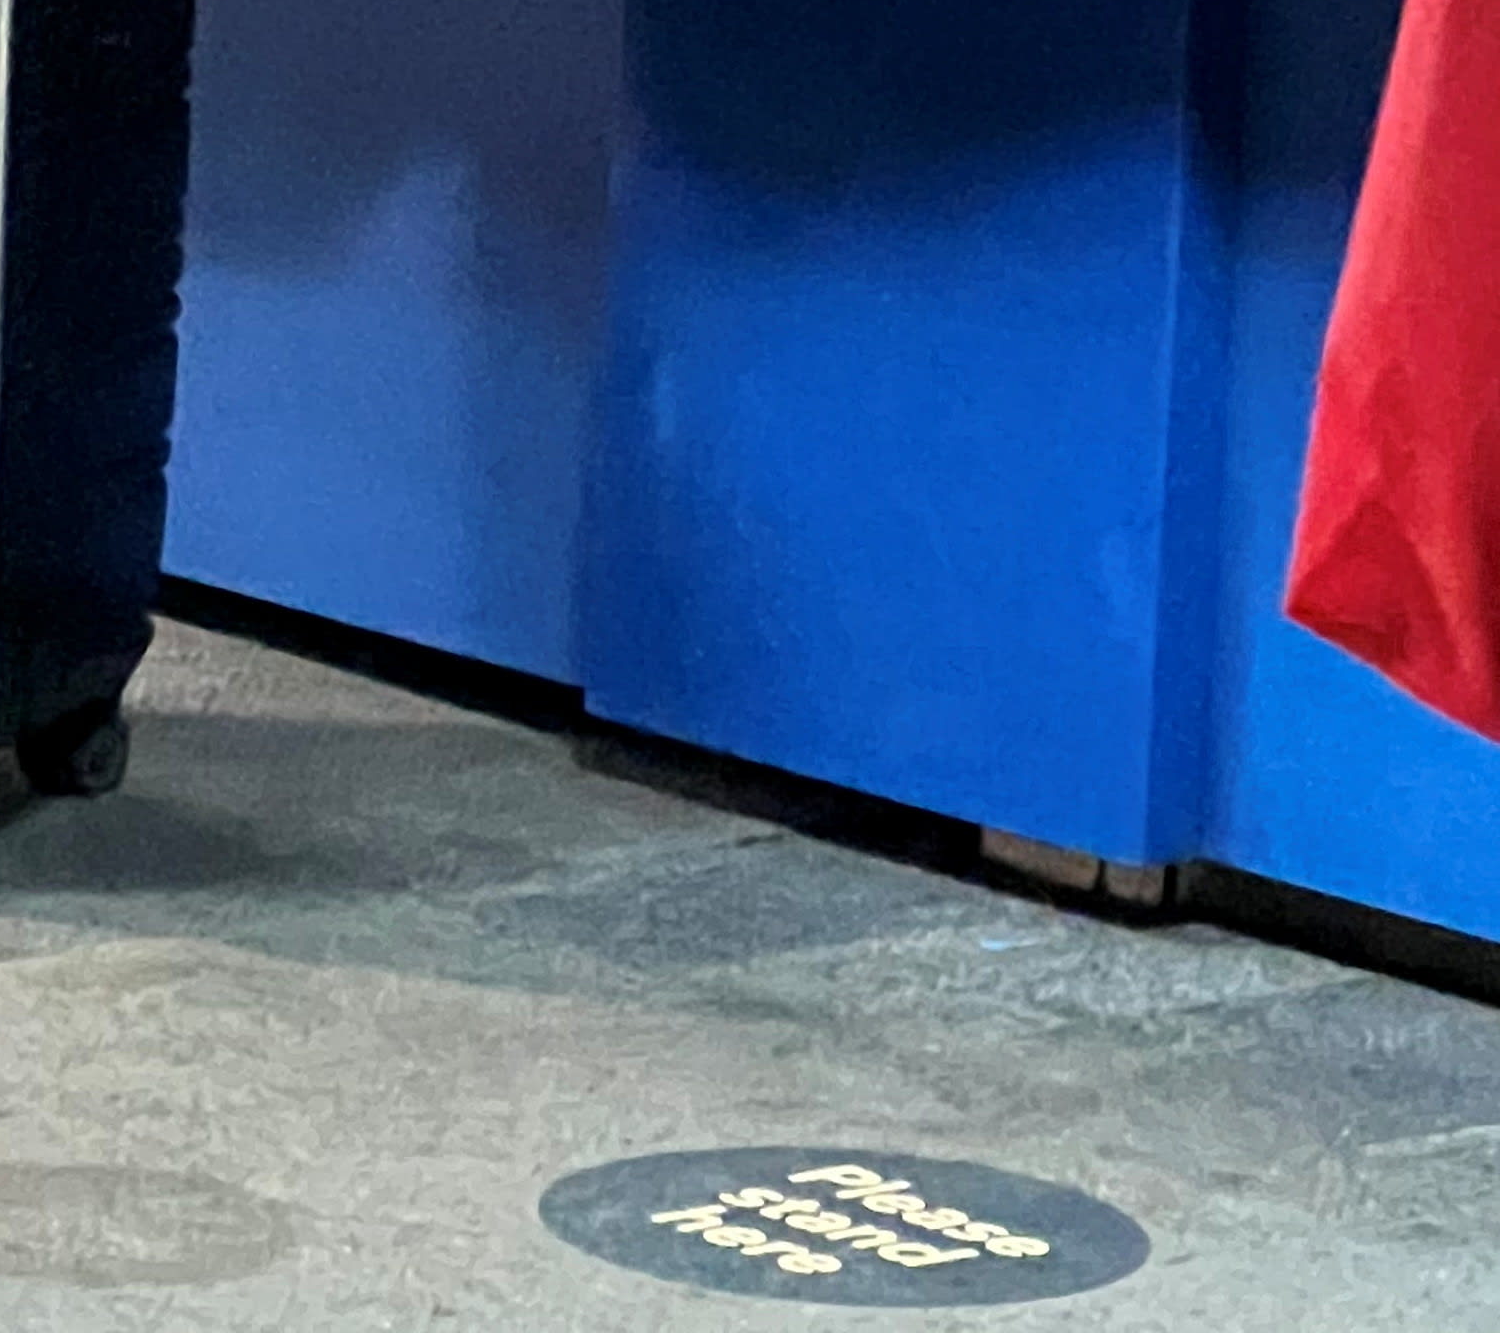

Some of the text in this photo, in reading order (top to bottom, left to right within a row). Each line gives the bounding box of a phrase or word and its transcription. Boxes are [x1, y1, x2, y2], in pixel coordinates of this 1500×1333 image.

[650, 1204, 843, 1274] here
[718, 1187, 981, 1268] stand
[787, 1163, 1051, 1258] Please
